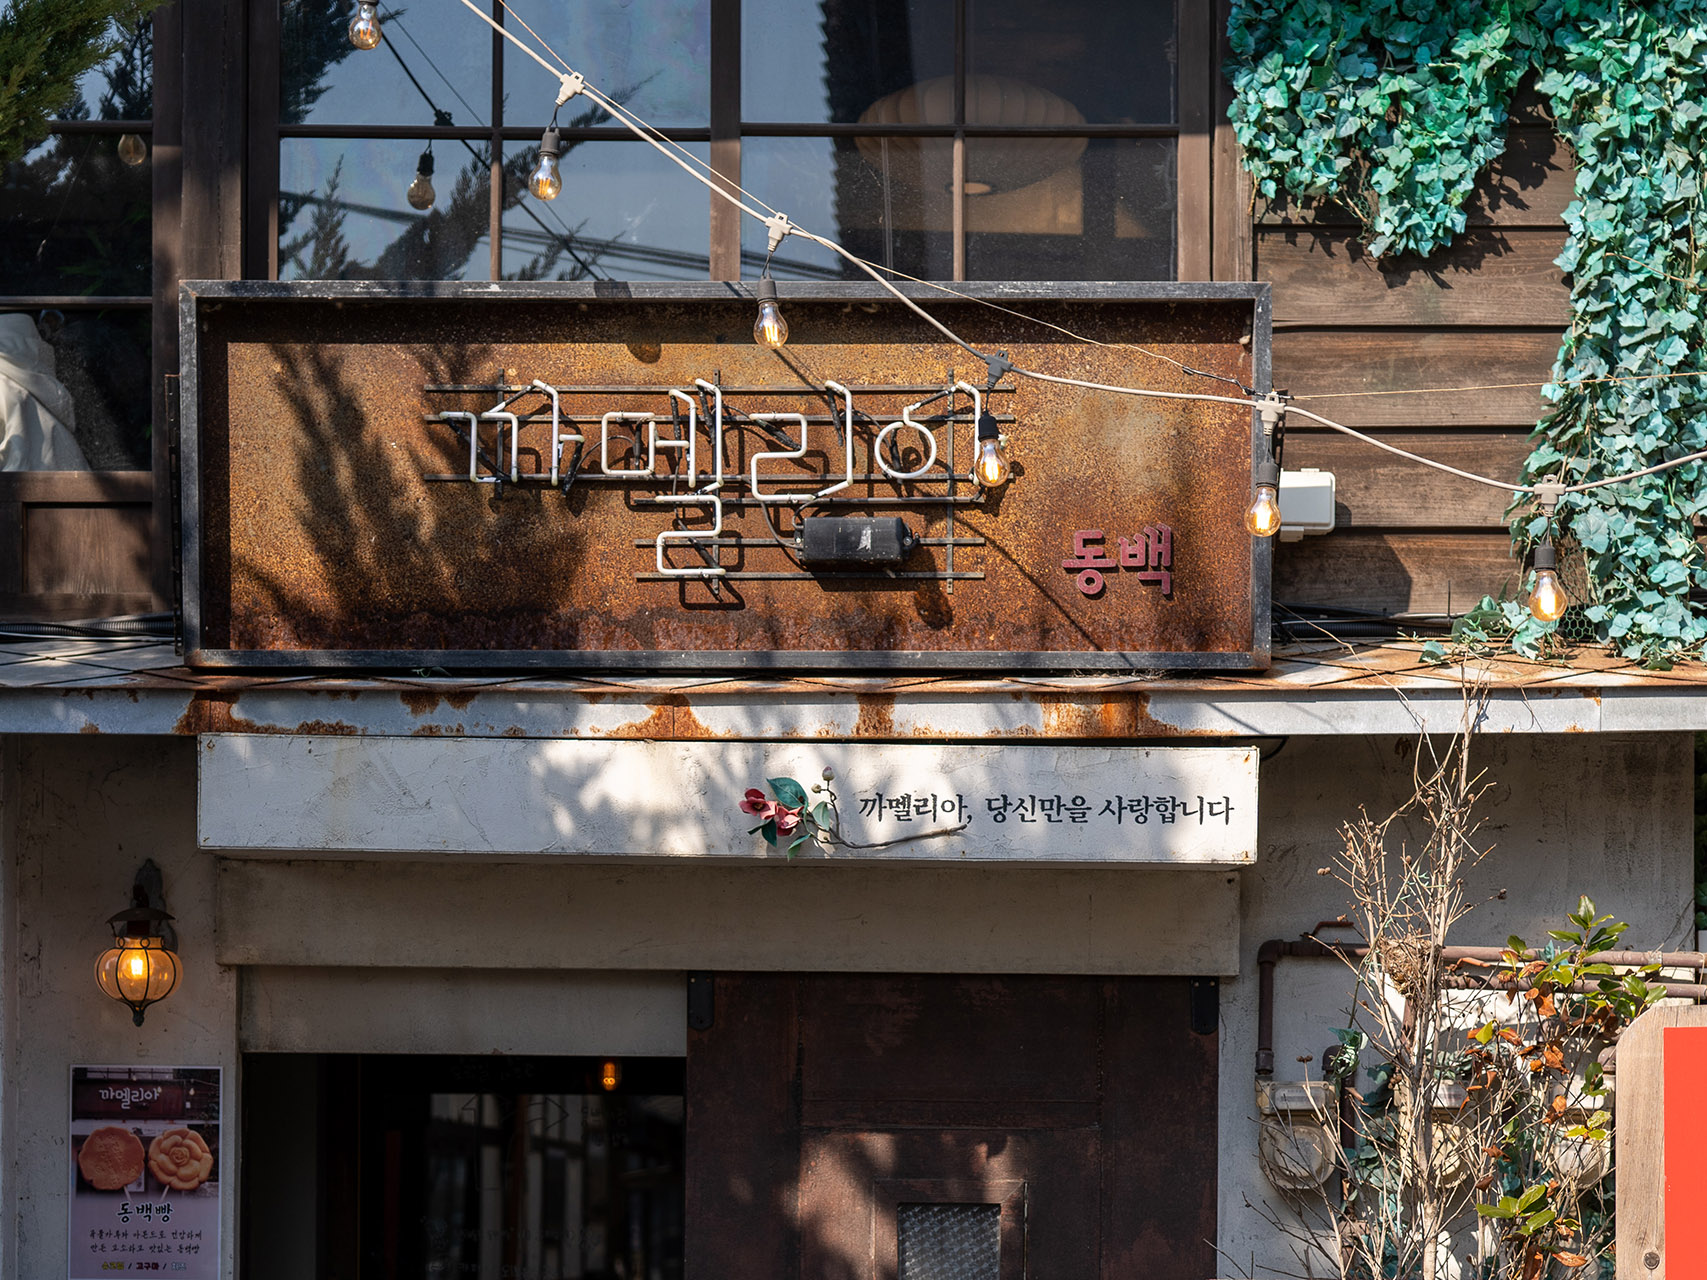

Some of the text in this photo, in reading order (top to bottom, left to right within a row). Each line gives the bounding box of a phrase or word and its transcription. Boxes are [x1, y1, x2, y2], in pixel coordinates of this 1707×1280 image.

[439, 379, 1009, 576] 까멜리아
[1062, 522, 1172, 595] 동백
[858, 792, 1236, 828] 까멜리아, 당신만을 사랑합니다
[98, 1086, 161, 1109] 까멜리아
[117, 1202, 174, 1224] 동백빵
[171, 1229, 202, 1241] 건강하게
[111, 1243, 145, 1254] 고소하고
[149, 1242, 172, 1254] 맛있는
[135, 1262, 160, 1271] 고구마
